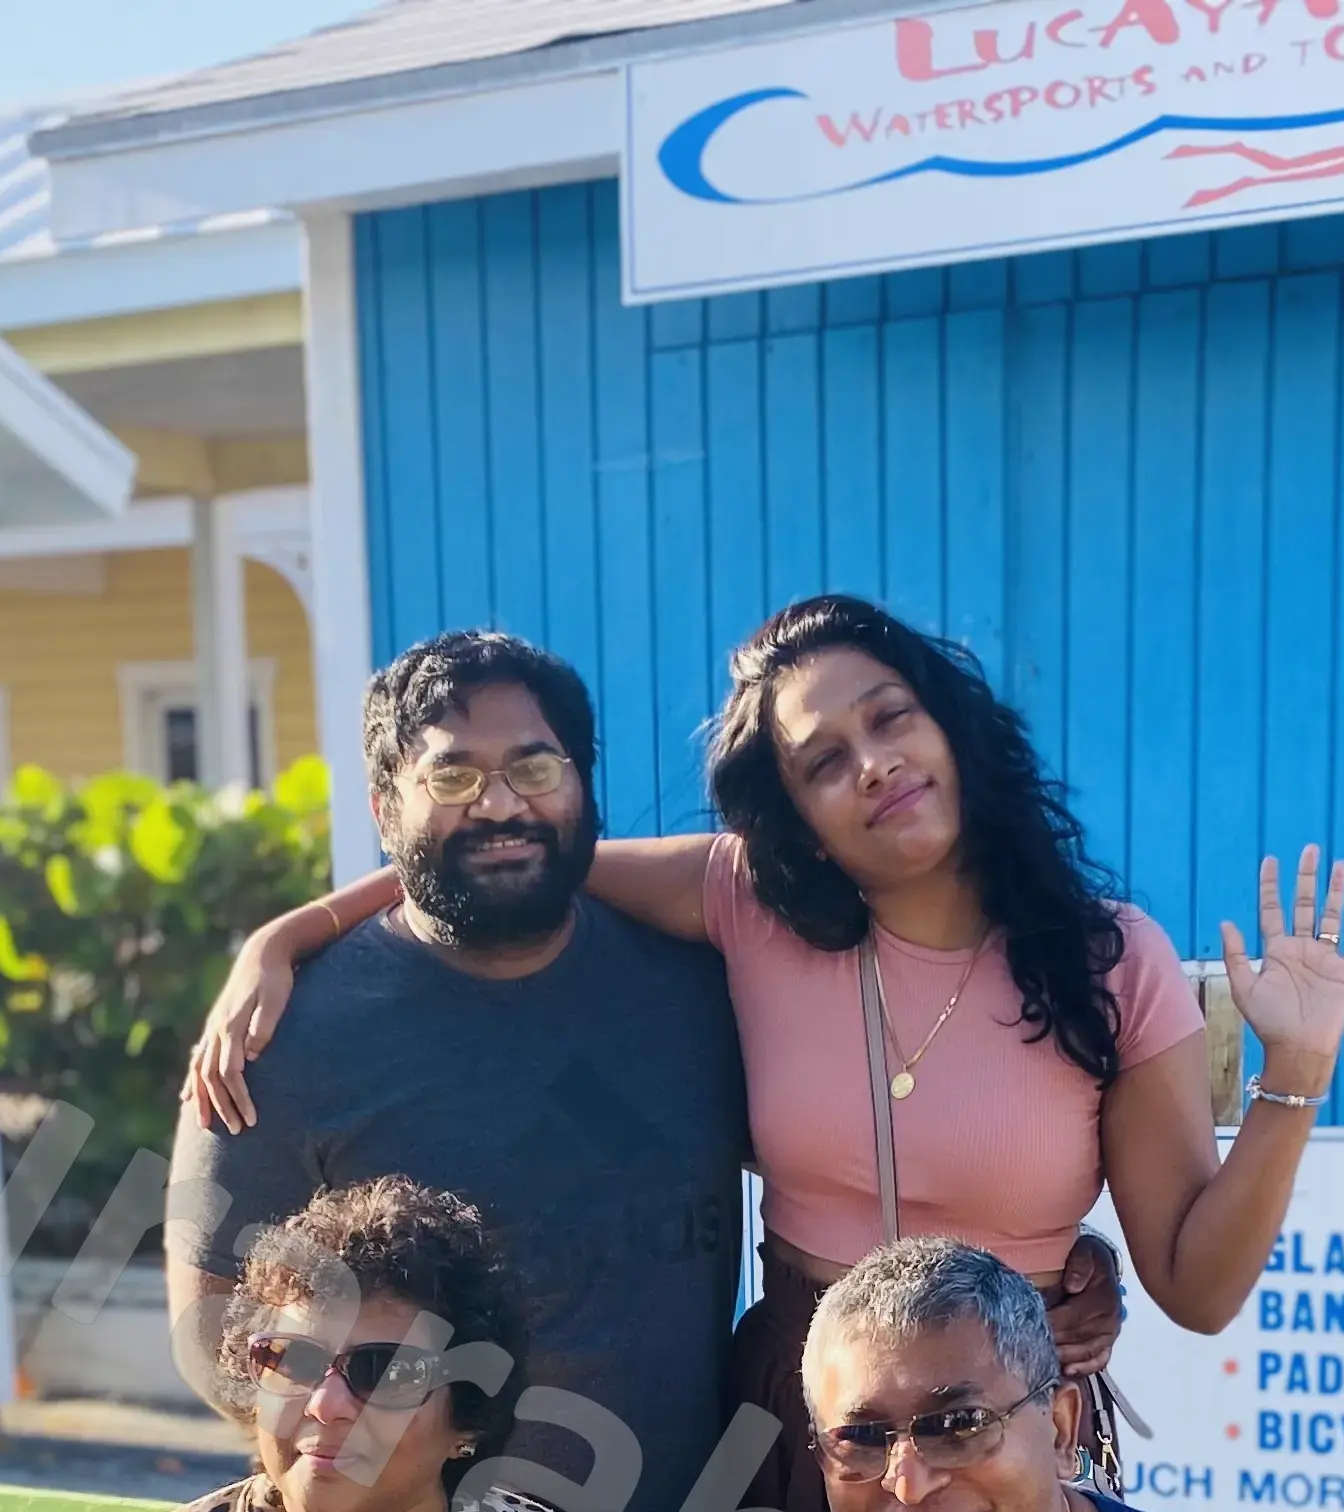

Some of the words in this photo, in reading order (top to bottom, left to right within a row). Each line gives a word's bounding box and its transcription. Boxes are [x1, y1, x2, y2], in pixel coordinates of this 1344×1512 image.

[815, 64, 1157, 148] WATERSPORTS
[1182, 53, 1267, 83] AND
[1124, 1461, 1213, 1499] UCH
